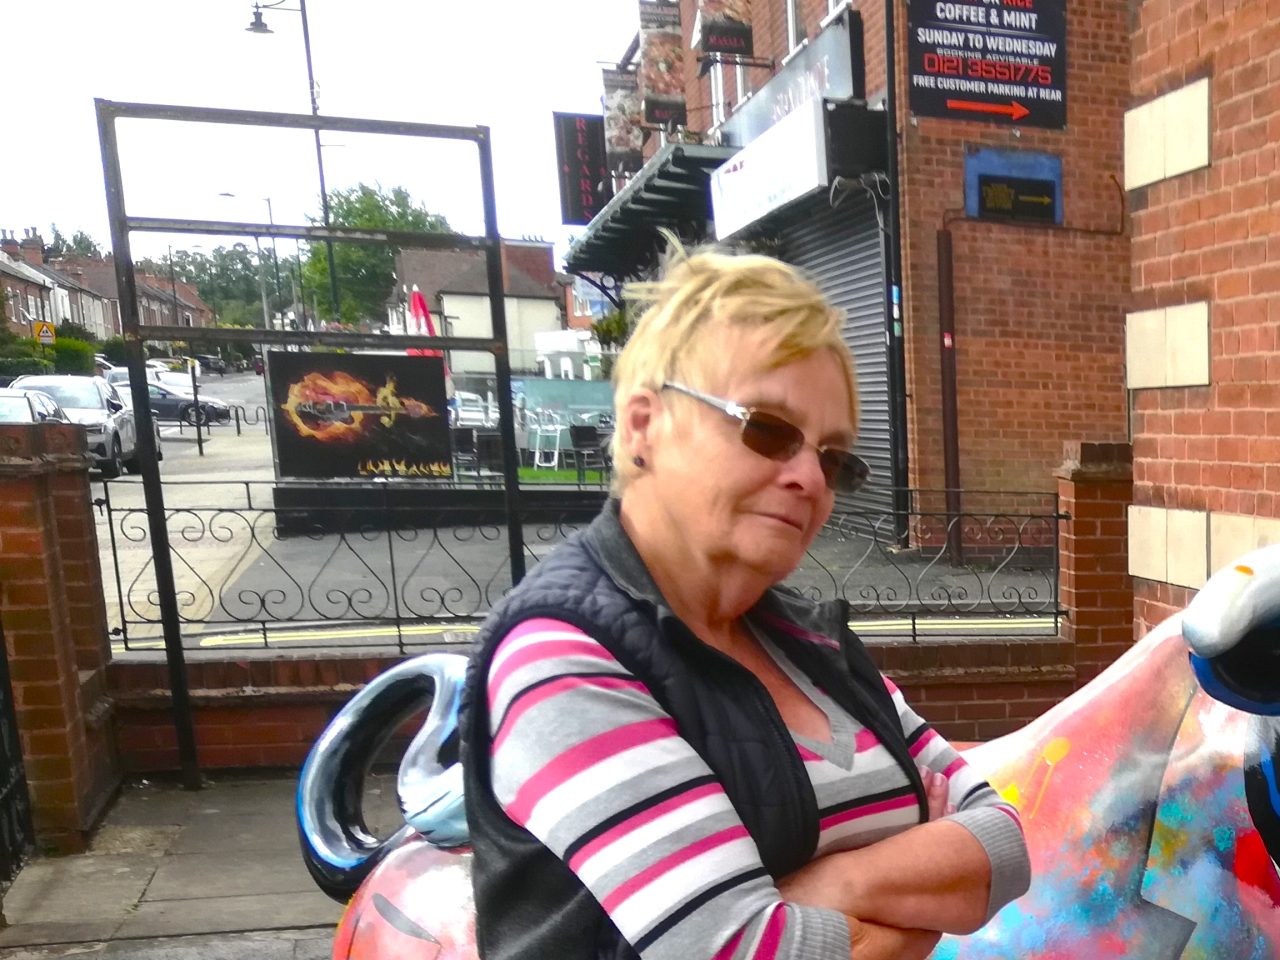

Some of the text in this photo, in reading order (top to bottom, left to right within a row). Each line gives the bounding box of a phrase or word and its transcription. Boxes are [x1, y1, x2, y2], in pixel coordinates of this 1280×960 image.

[936, 2, 1037, 30] COFFEE & MINT
[917, 27, 1057, 58] SUNDAY TO WEDNESDAY
[924, 53, 1051, 85] 0121 3551775
[913, 75, 1062, 102] FREE CUSTOMER PARKING AT REAR
